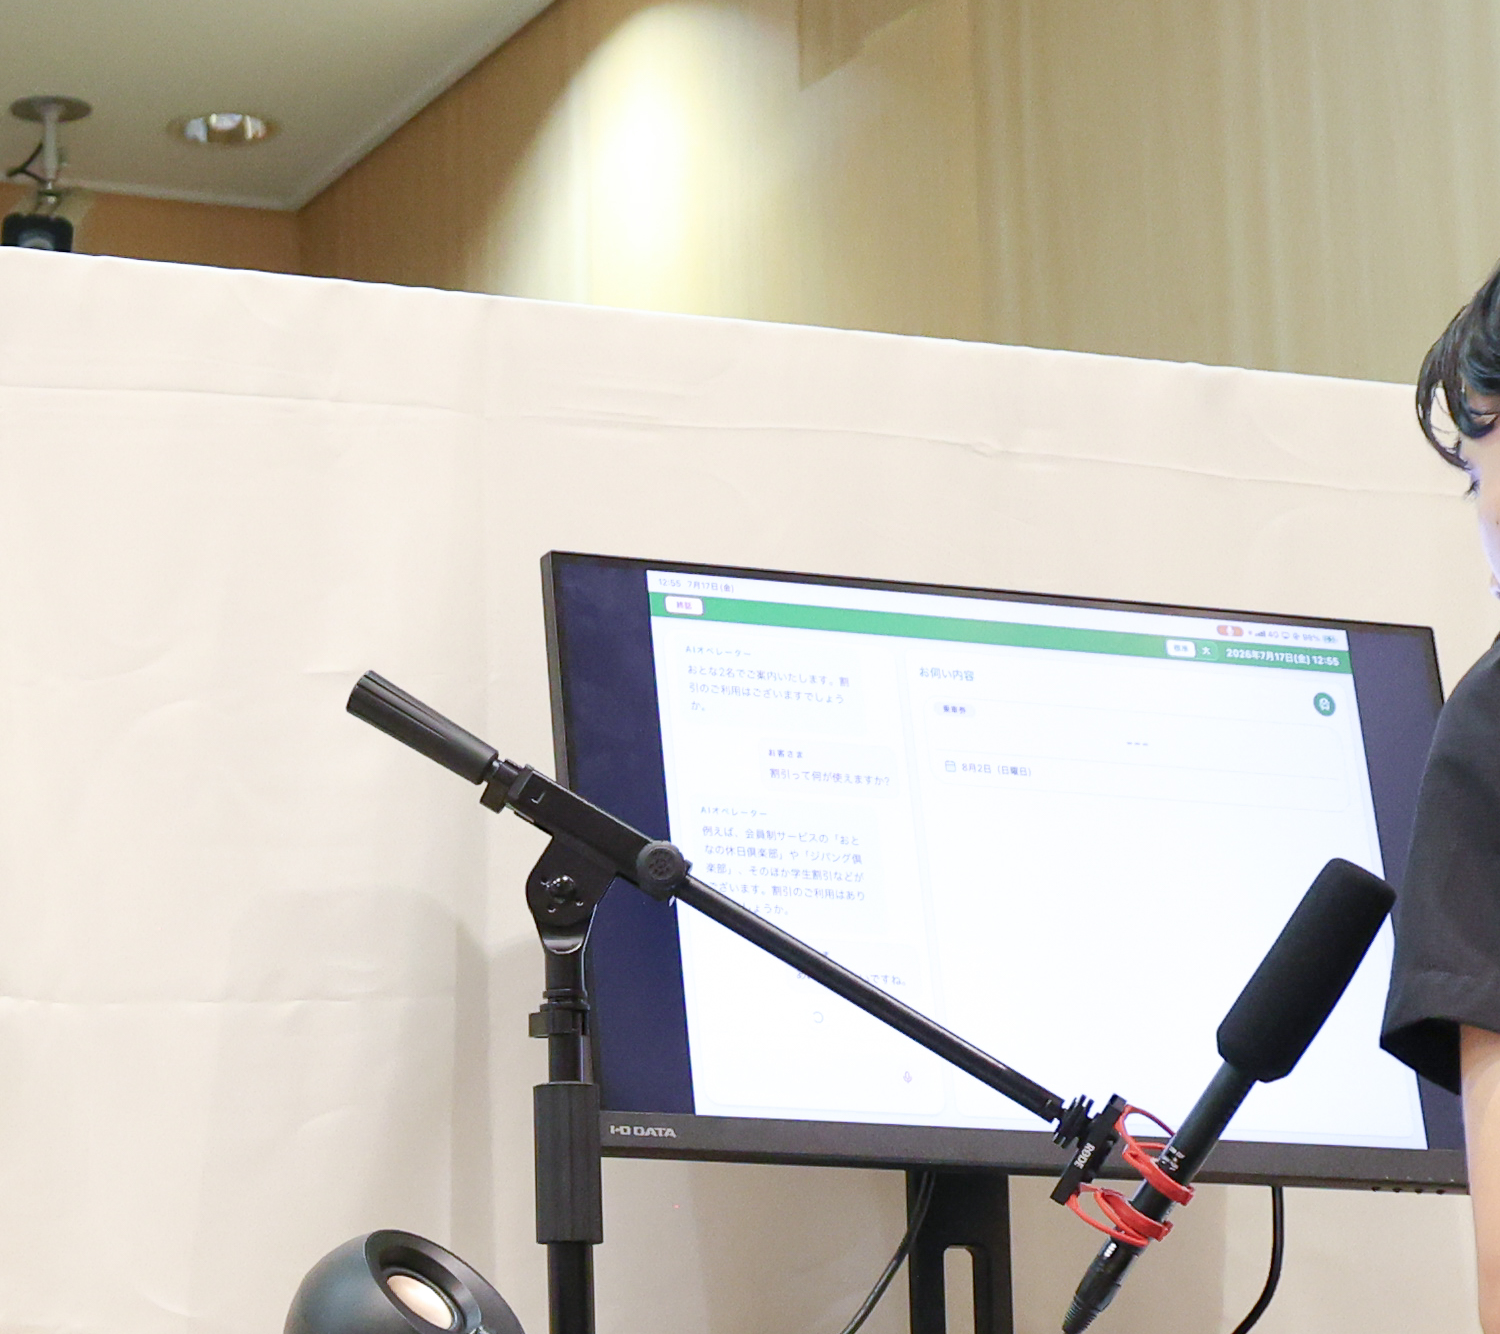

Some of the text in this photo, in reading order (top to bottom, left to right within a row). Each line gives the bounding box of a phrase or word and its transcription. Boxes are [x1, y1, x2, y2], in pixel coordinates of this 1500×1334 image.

[658, 578, 682, 588] 12:55
[685, 645, 752, 657] AIオペレーター
[1312, 654, 1340, 666] 12:55
[919, 666, 975, 682] お伺い内容
[633, 1126, 677, 1138] DATA
